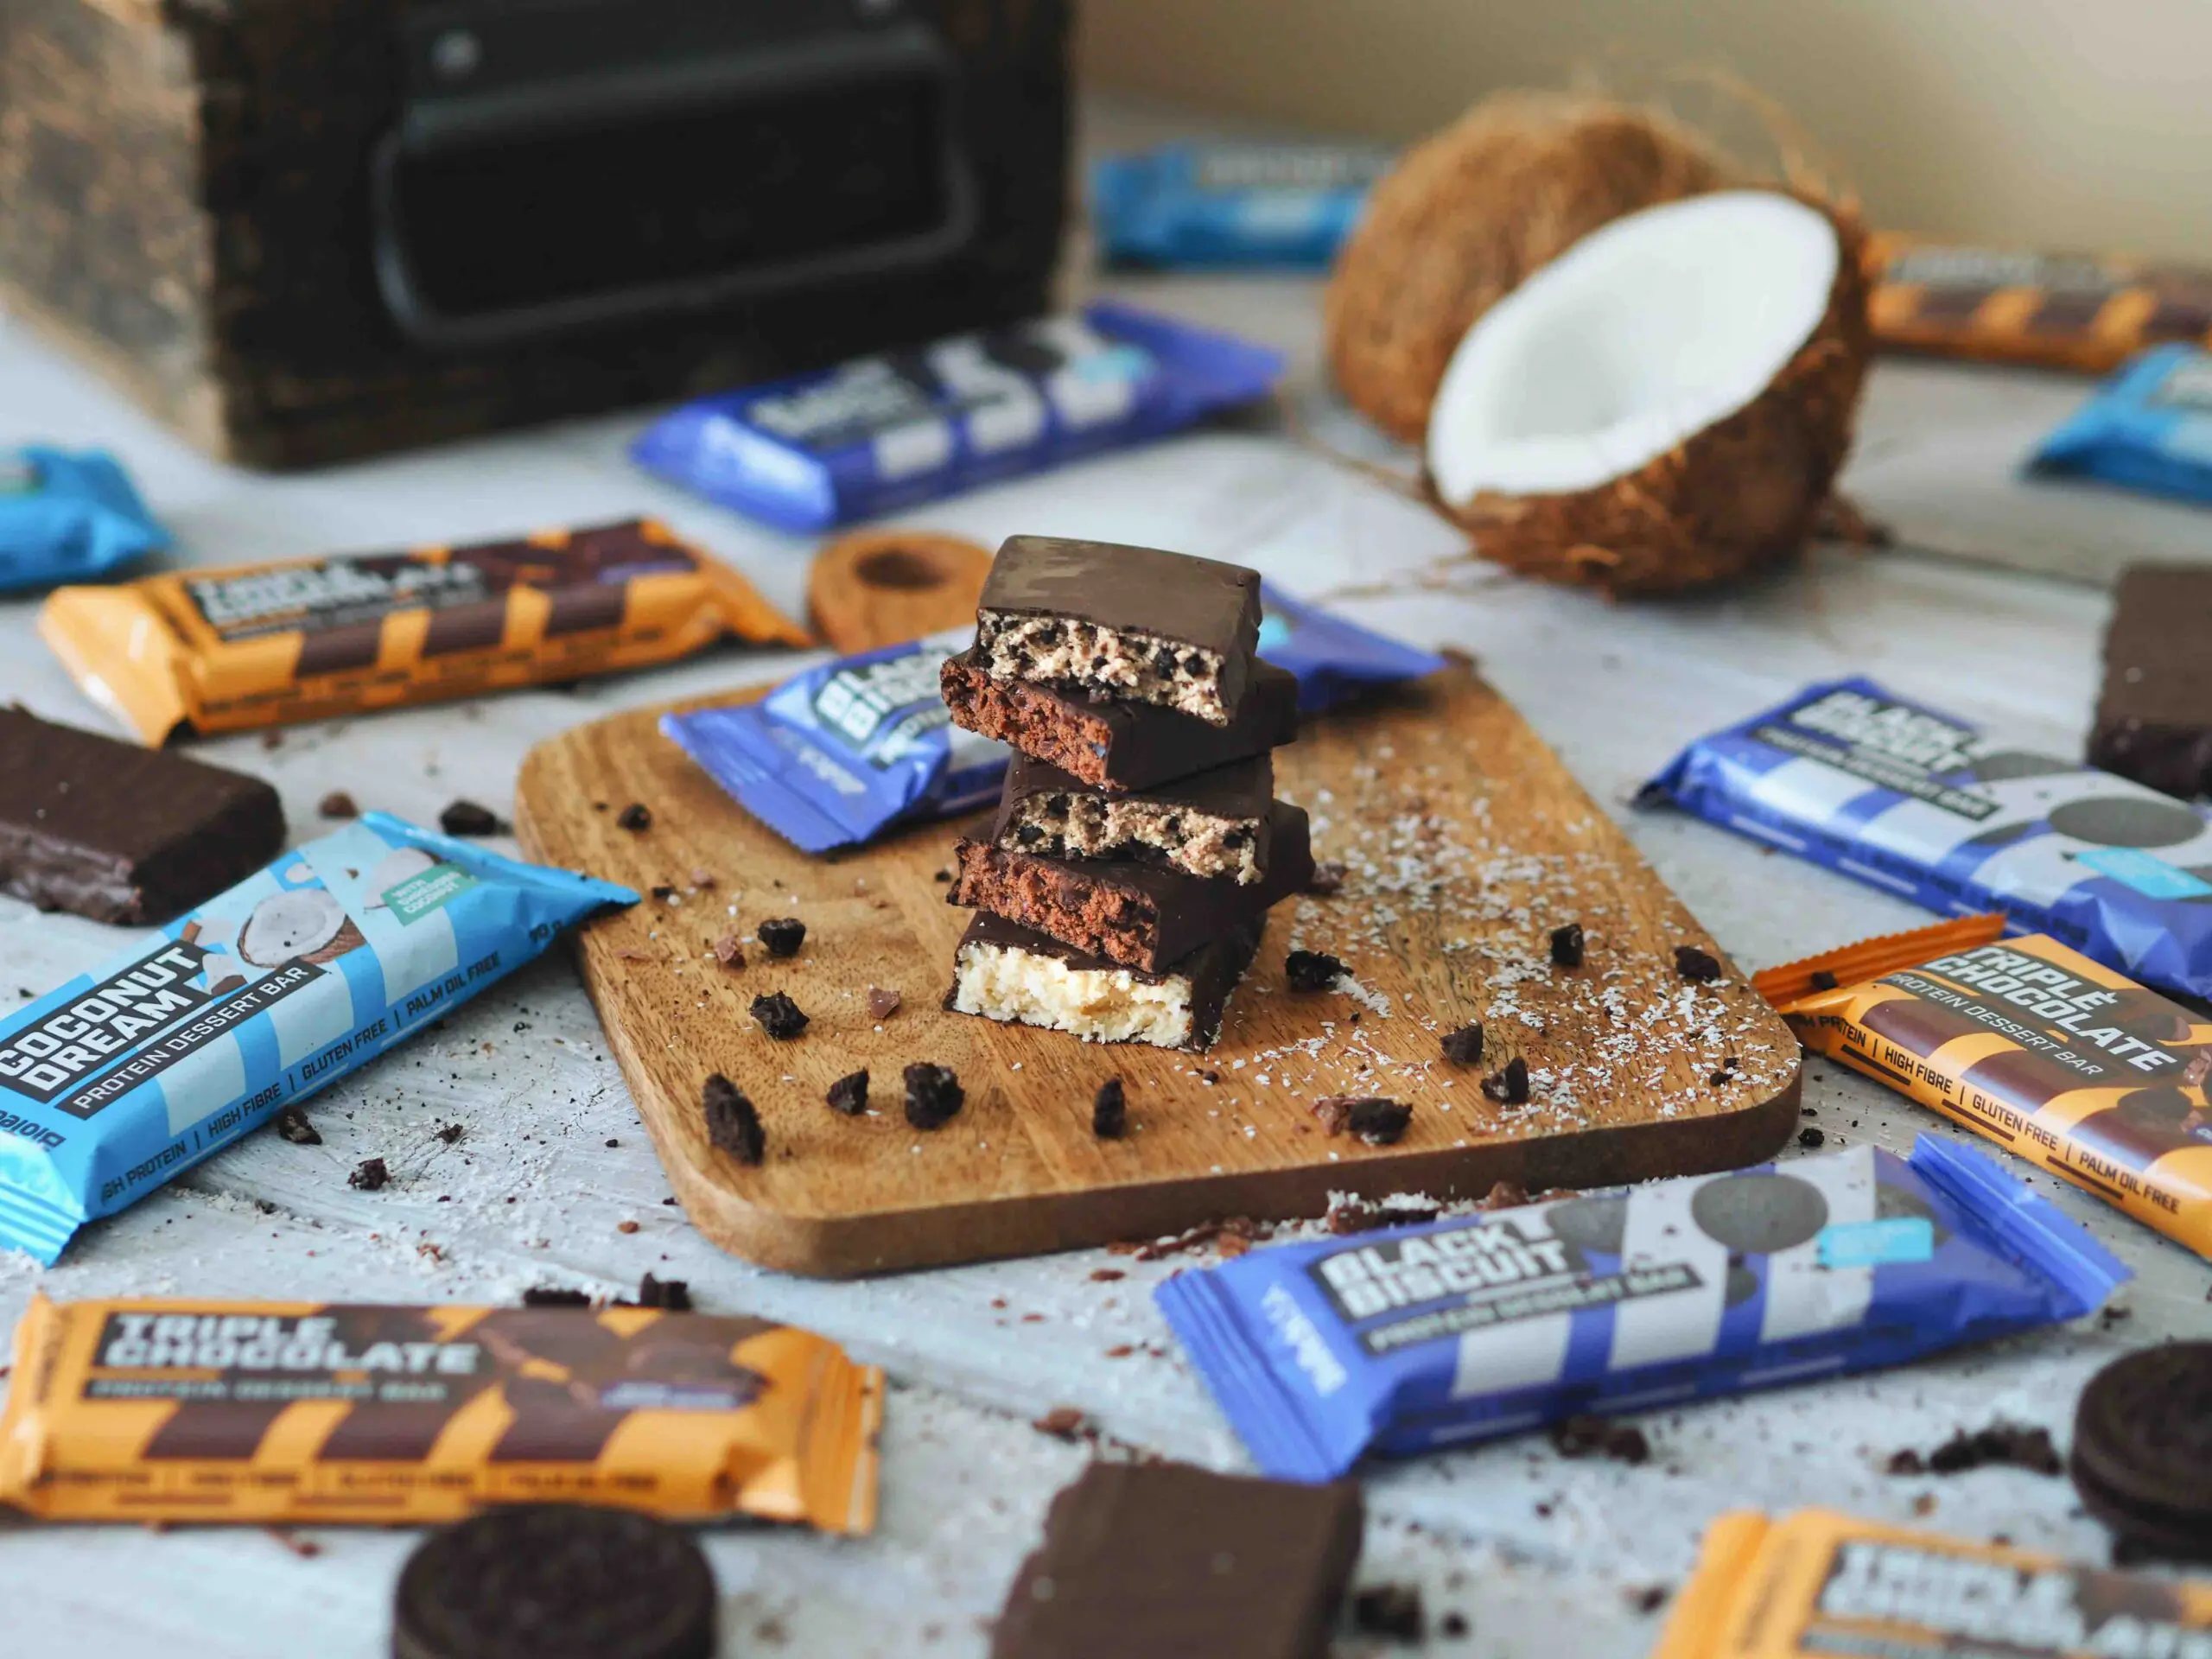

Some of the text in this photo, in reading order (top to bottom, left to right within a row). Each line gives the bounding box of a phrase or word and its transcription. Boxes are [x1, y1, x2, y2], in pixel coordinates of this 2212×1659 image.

[0, 947, 199, 1077] COCONUT
[1890, 973, 2104, 1077] PROTEIN DESSERT BAR
[1923, 957, 2178, 1071] CHOCOLATE
[1967, 946, 2117, 1014] TRIPLE
[20, 988, 194, 1092] DREAM
[73, 966, 309, 1109] PROTEIN DESSERT BAR
[127, 1140, 188, 1188] PROTEIN
[207, 1109, 242, 1139] HIGH
[243, 1083, 283, 1117] FIBRE
[302, 1041, 354, 1080] GLUTEN
[354, 1017, 388, 1049] FREE
[405, 987, 443, 1016] PALM
[445, 973, 467, 995] OIL
[467, 950, 500, 981] FREE
[1885, 1046, 1914, 1075] HIGH
[1916, 1064, 1953, 1095] FIBRE
[1972, 1094, 2024, 1133] GLUTEN
[2024, 1121, 2060, 1152] FREE
[2079, 1151, 2120, 1184] PALM
[2119, 1172, 2141, 1197] OIL
[2143, 1185, 2180, 1215] FREE
[1321, 1222, 1522, 1283] BLACK
[1339, 1238, 1568, 1319] BISCUIT
[104, 1339, 481, 1373] CHOCOLATE
[116, 1313, 338, 1342] TRIPLE
